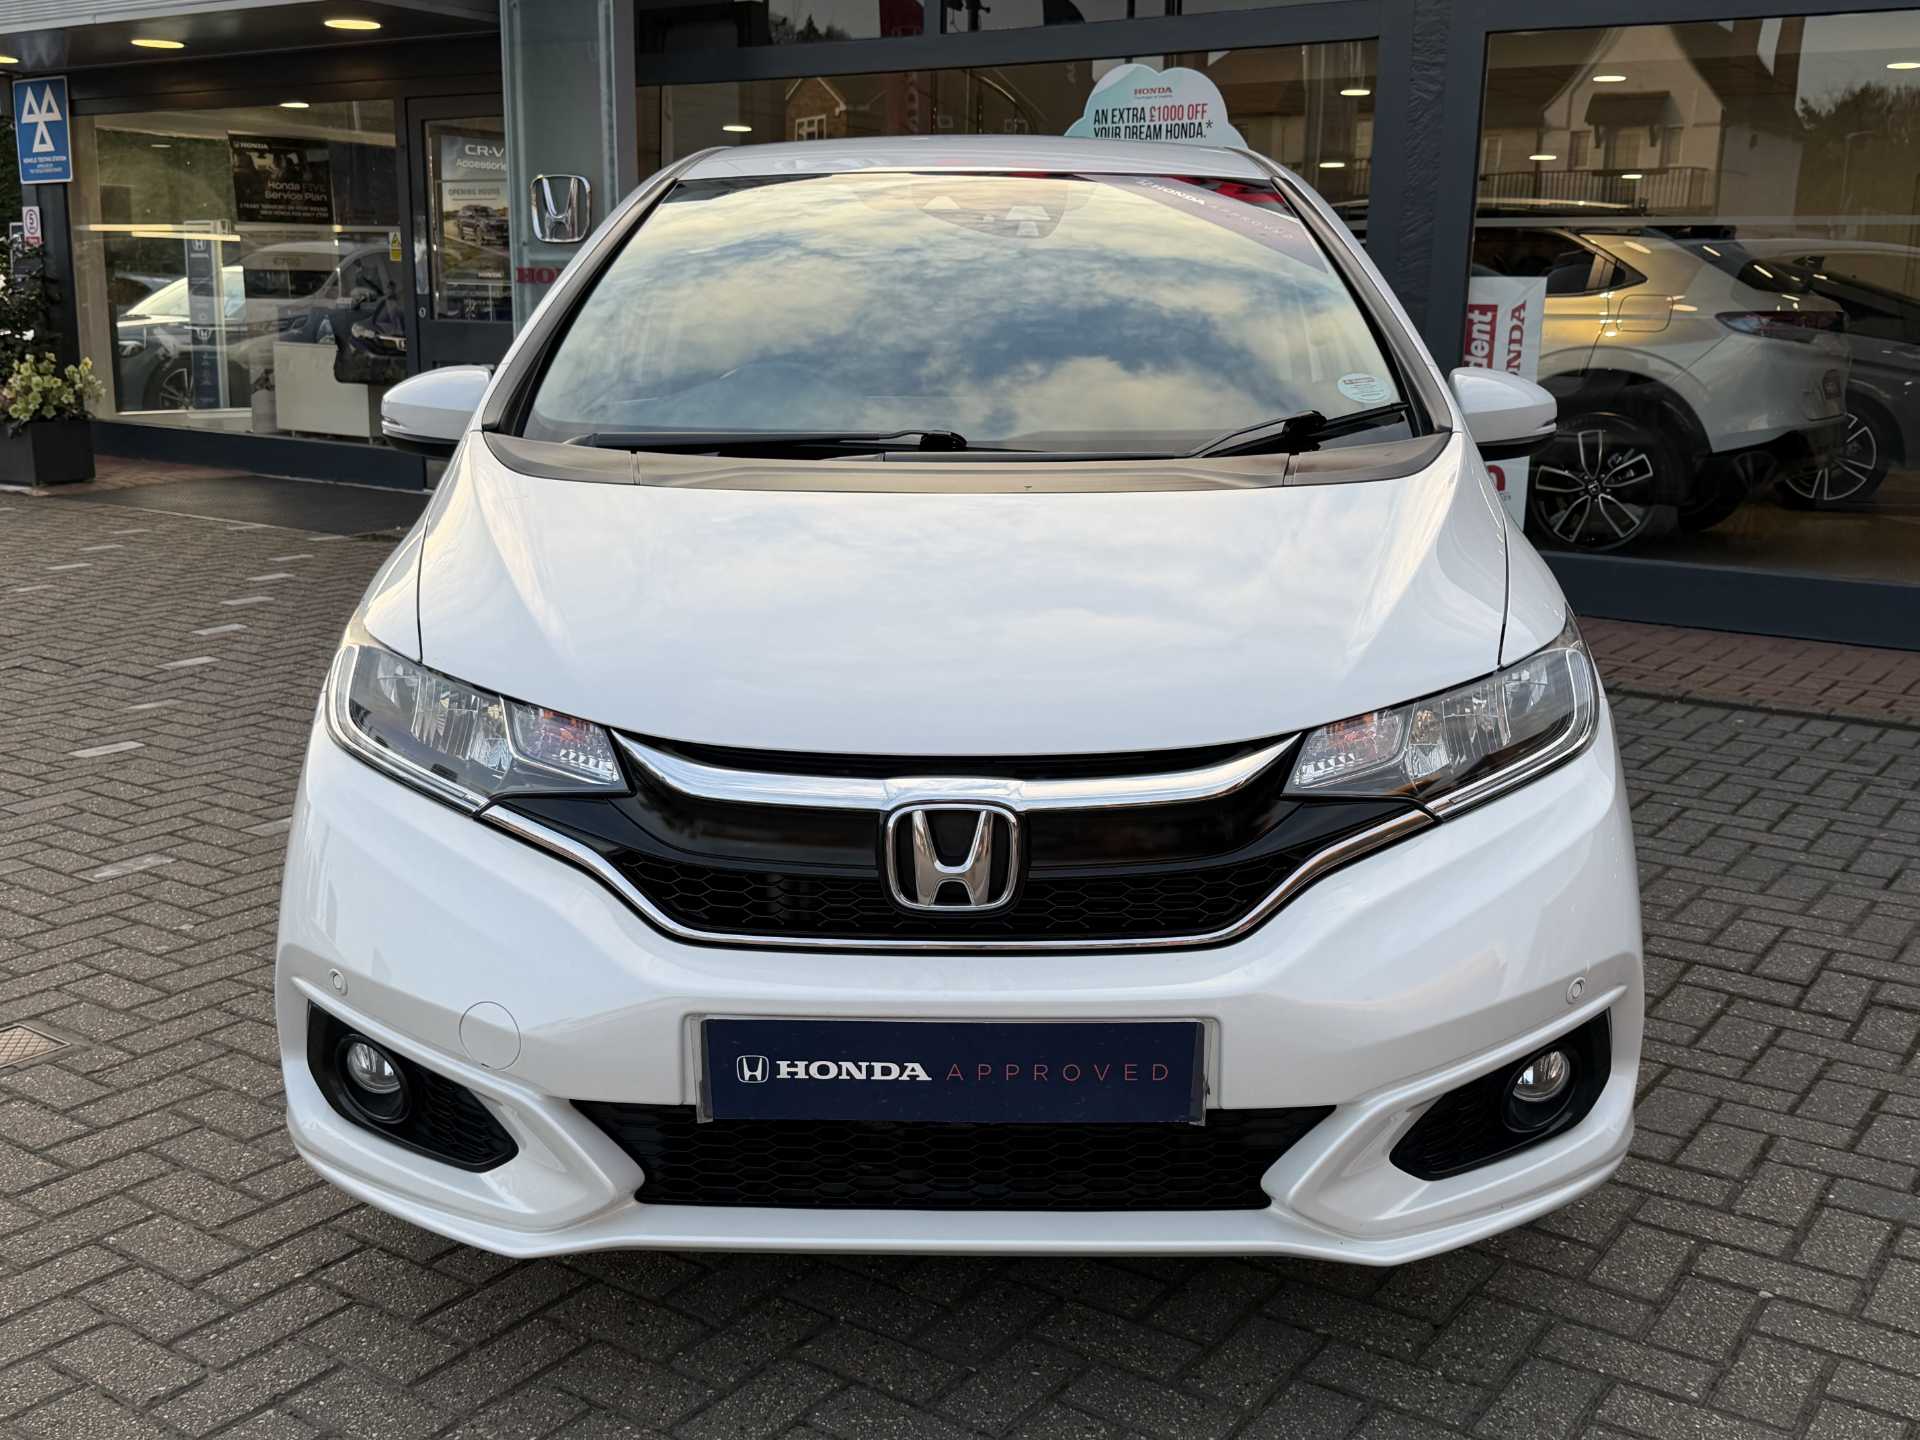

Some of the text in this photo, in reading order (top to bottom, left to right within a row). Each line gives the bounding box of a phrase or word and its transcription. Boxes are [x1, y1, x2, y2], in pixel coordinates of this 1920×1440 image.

[1134, 87, 1173, 96] HONDA
[1094, 103, 1208, 125] AN EXTRA £1000 OFF
[1124, 123, 1162, 140] DREAM
[265, 191, 328, 201] Service Plan
[516, 266, 561, 284] HO
[775, 1060, 1170, 1082] HONDA APPROVED
